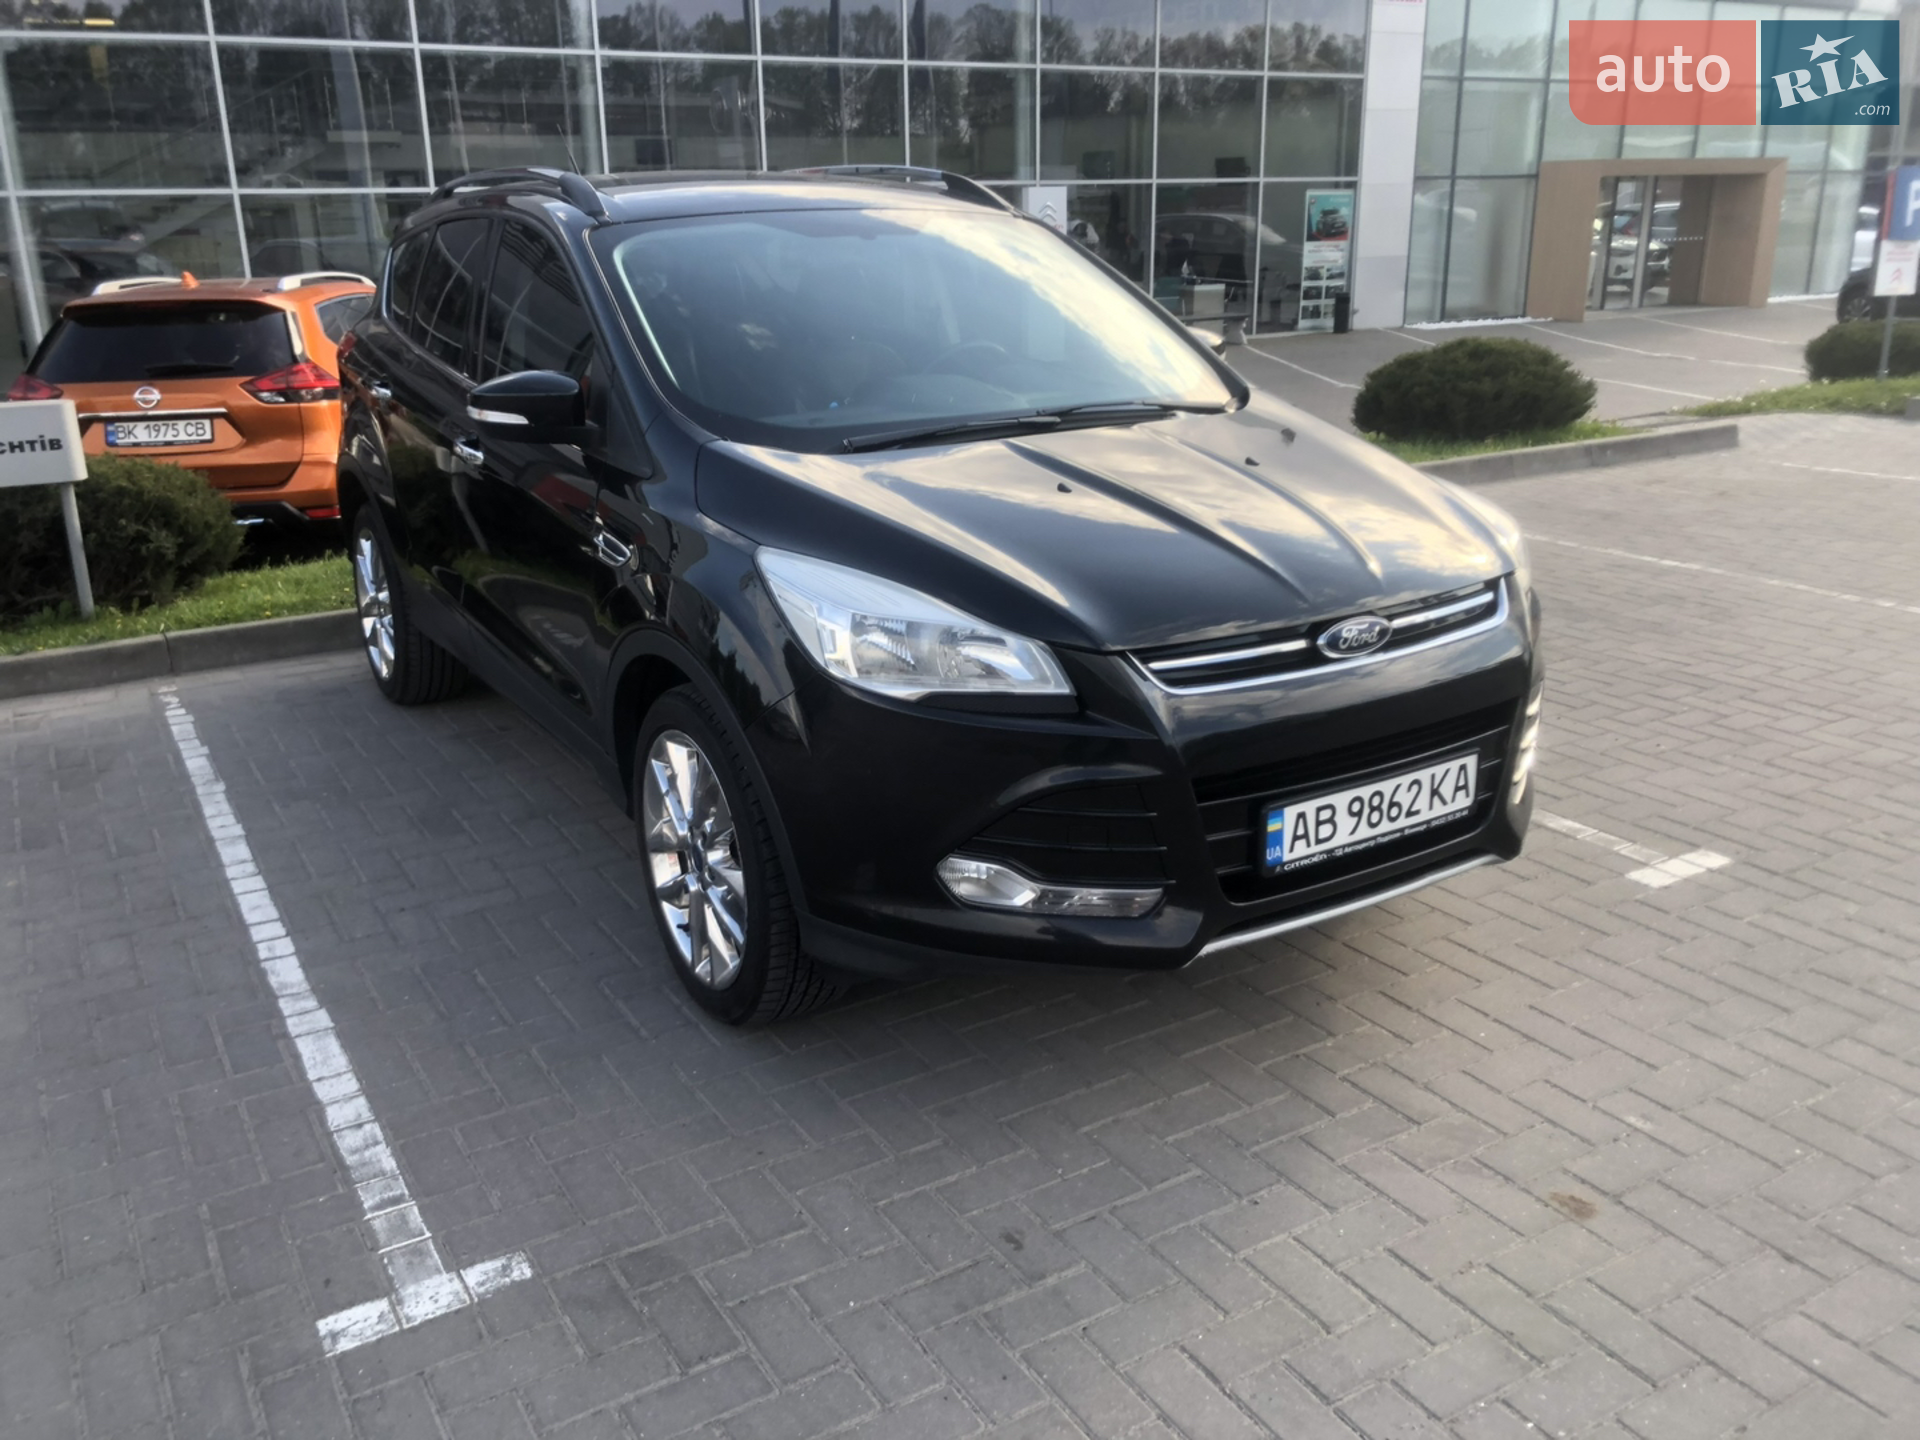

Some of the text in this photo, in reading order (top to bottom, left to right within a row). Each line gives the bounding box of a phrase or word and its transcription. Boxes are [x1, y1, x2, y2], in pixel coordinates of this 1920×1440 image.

[116, 421, 207, 440] BK 1975 CB
[1339, 622, 1381, 650] Ford
[1288, 762, 1470, 854] AB 9862 KA
[1266, 845, 1282, 860] UA
